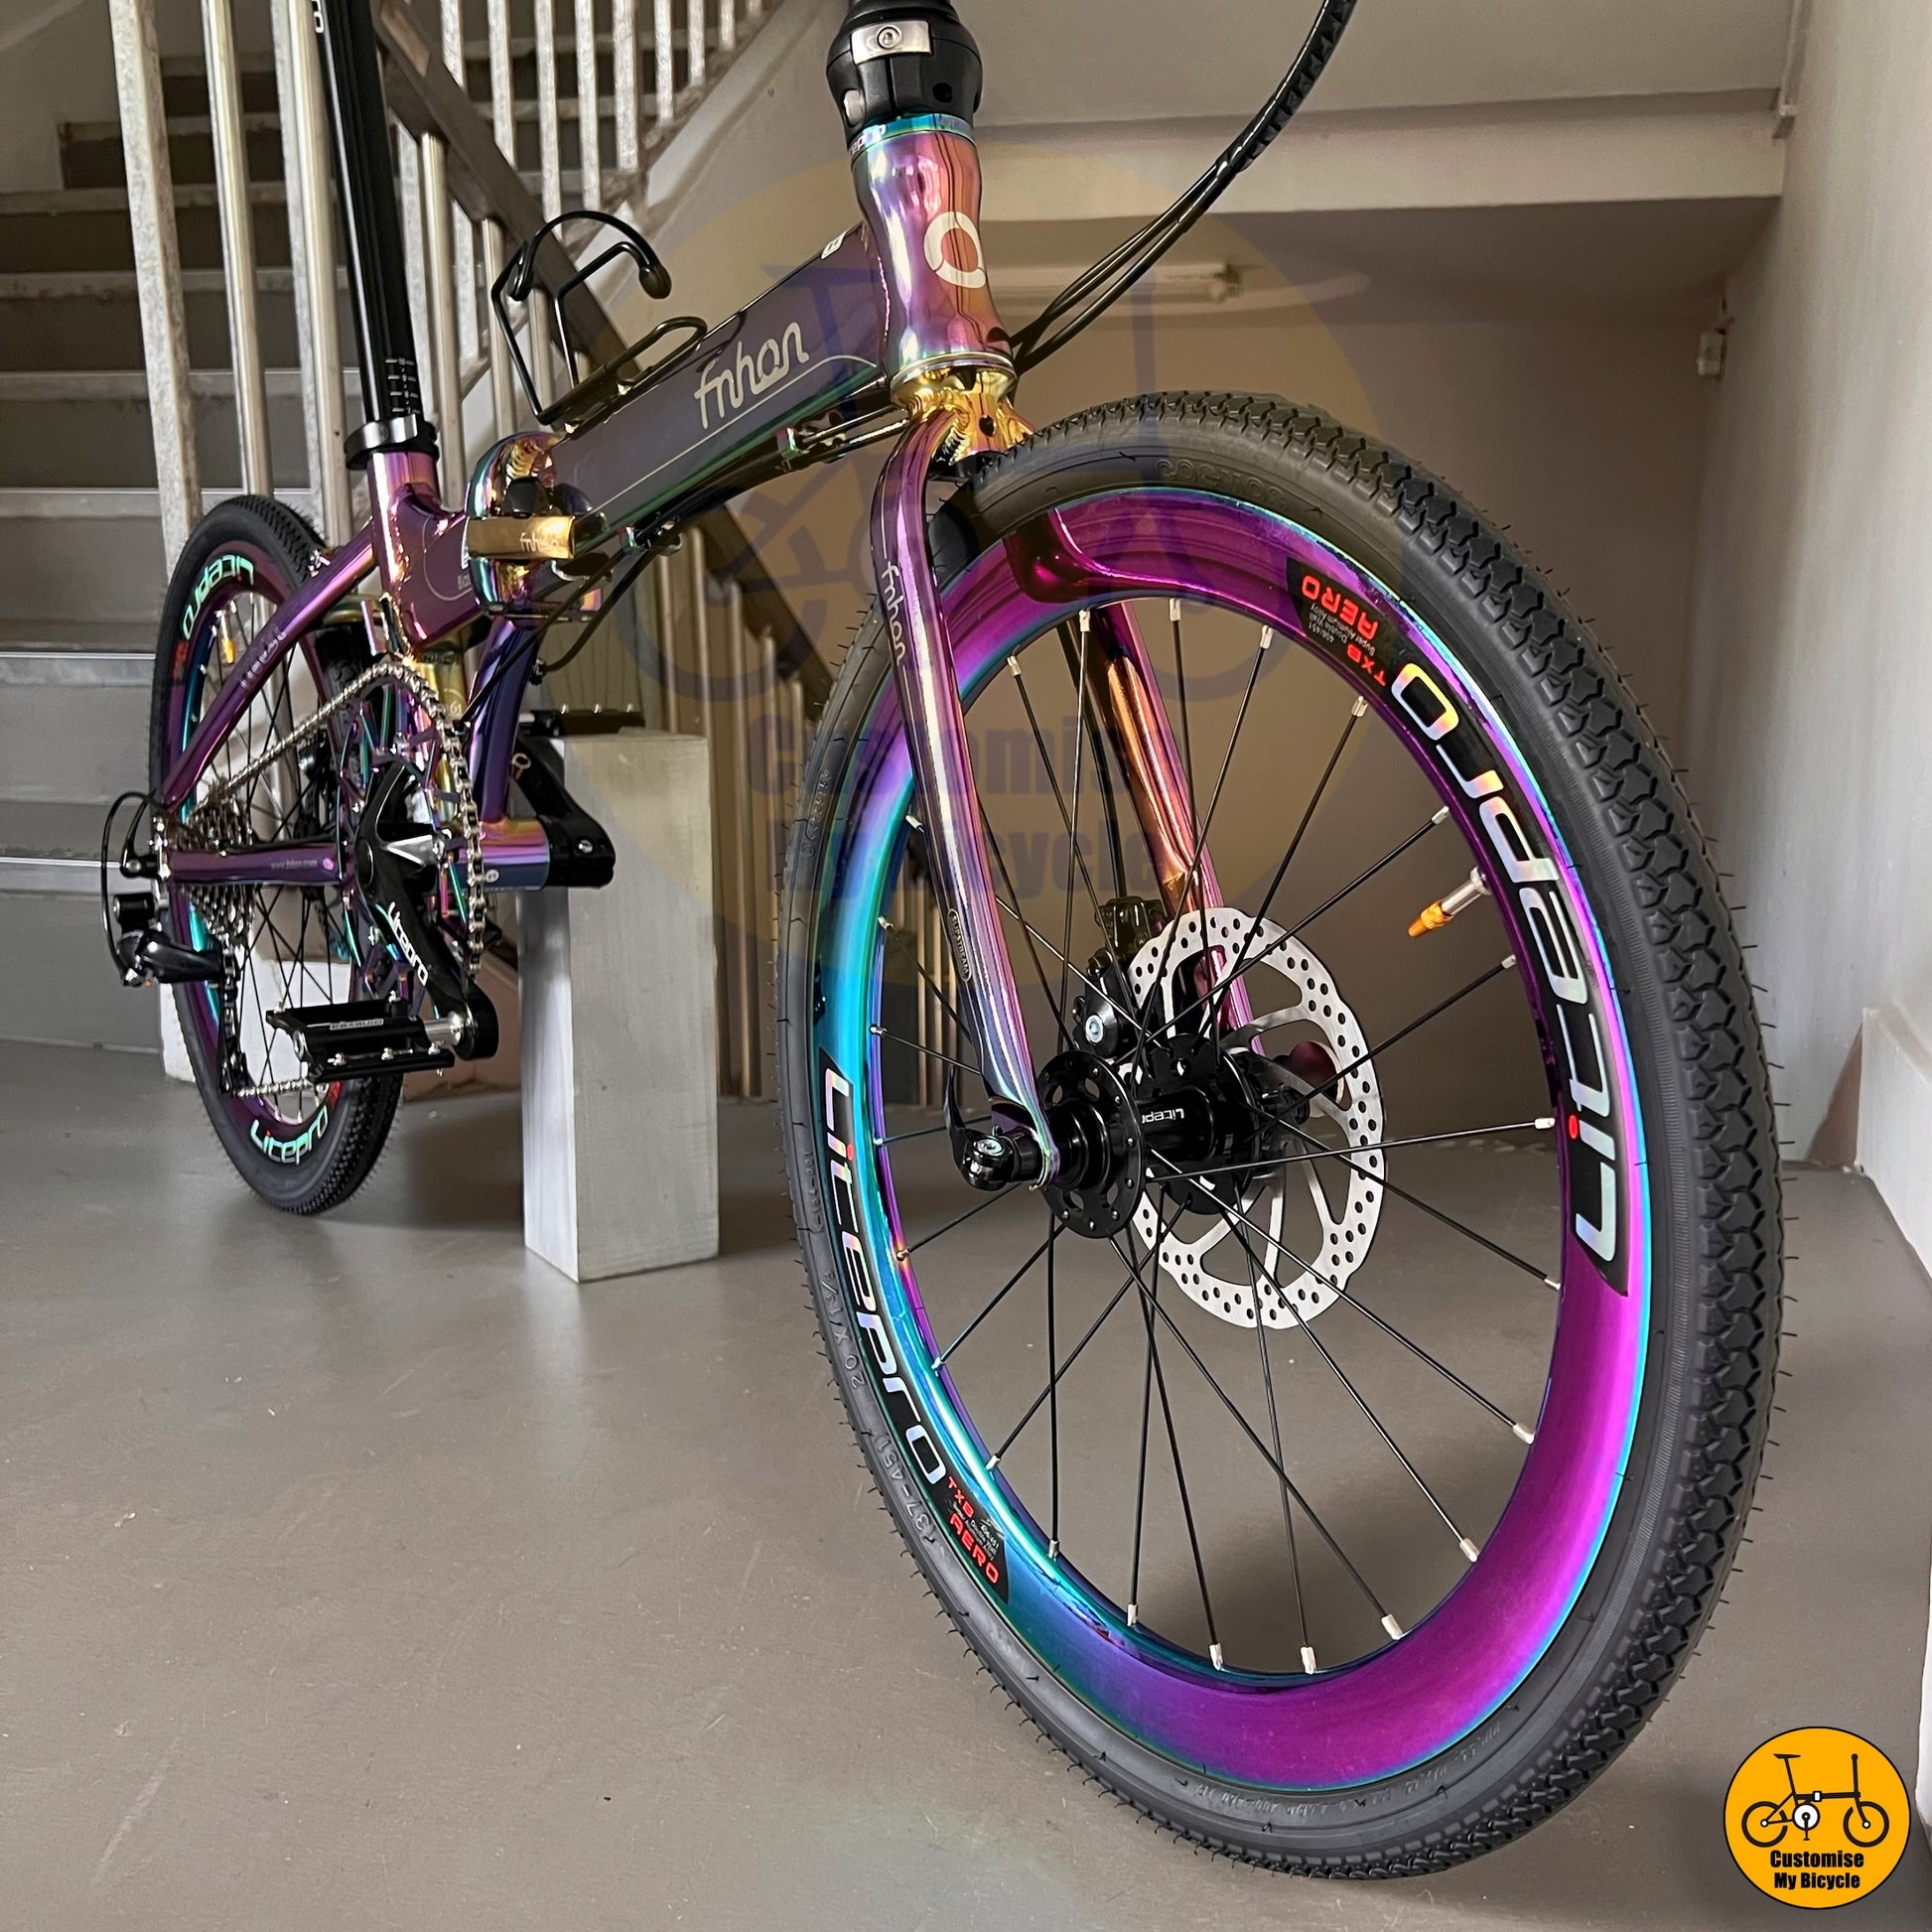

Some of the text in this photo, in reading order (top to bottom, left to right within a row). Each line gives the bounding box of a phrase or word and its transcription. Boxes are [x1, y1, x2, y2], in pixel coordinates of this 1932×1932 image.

[1302, 575, 1379, 640] AERO
[1391, 662, 1616, 1262] Litepro
[250, 1104, 329, 1166] Litepro
[1142, 1107, 1184, 1124] Litepr
[823, 1067, 947, 1485] Litepro
[843, 1353, 867, 1390] 20
[949, 1512, 999, 1584] AERO
